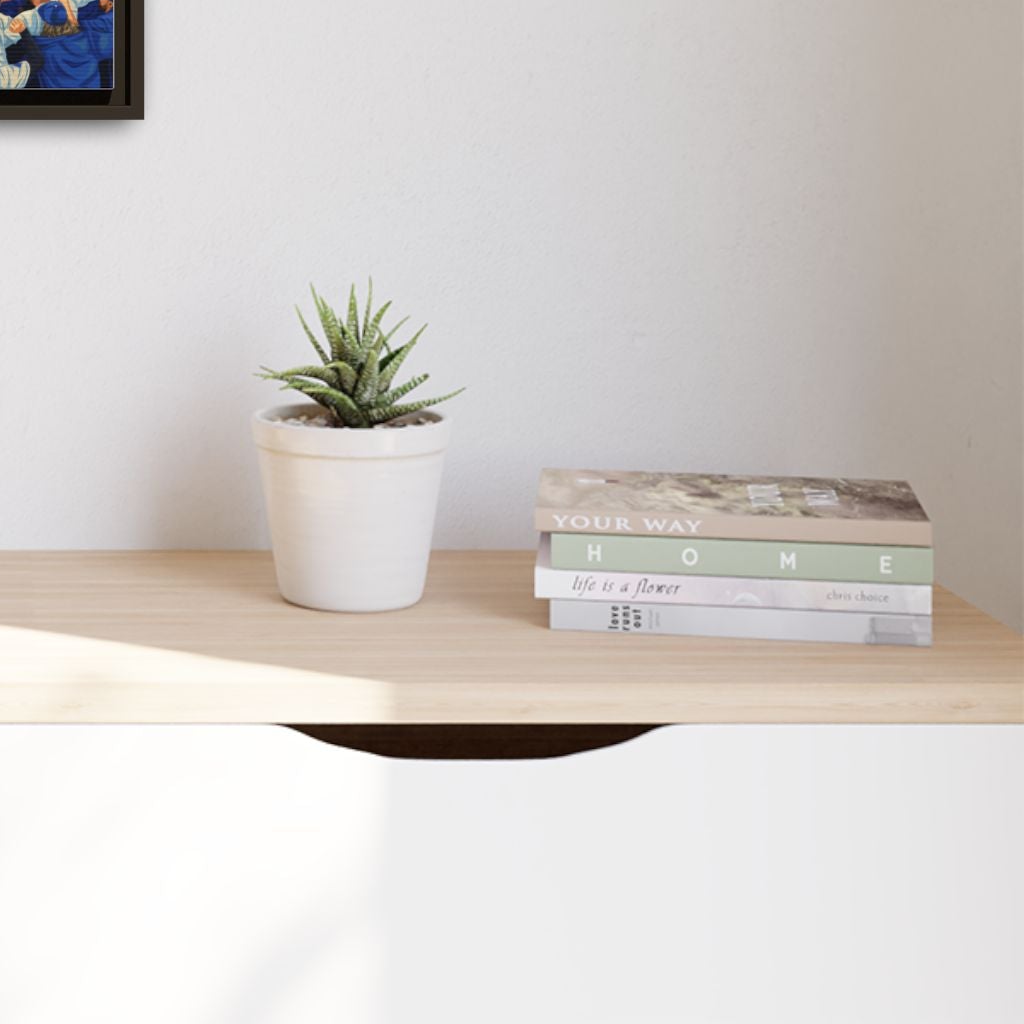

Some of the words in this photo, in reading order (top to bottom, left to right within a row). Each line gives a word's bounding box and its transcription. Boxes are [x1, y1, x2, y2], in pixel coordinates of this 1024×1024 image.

[552, 514, 632, 532] YOUR
[643, 517, 704, 534] WAY
[572, 574, 597, 593] life
[602, 578, 615, 592] is
[619, 582, 630, 593] a
[632, 578, 682, 598] flower
[825, 589, 852, 602] chris
[854, 590, 890, 604] choice
[608, 605, 619, 630] love
